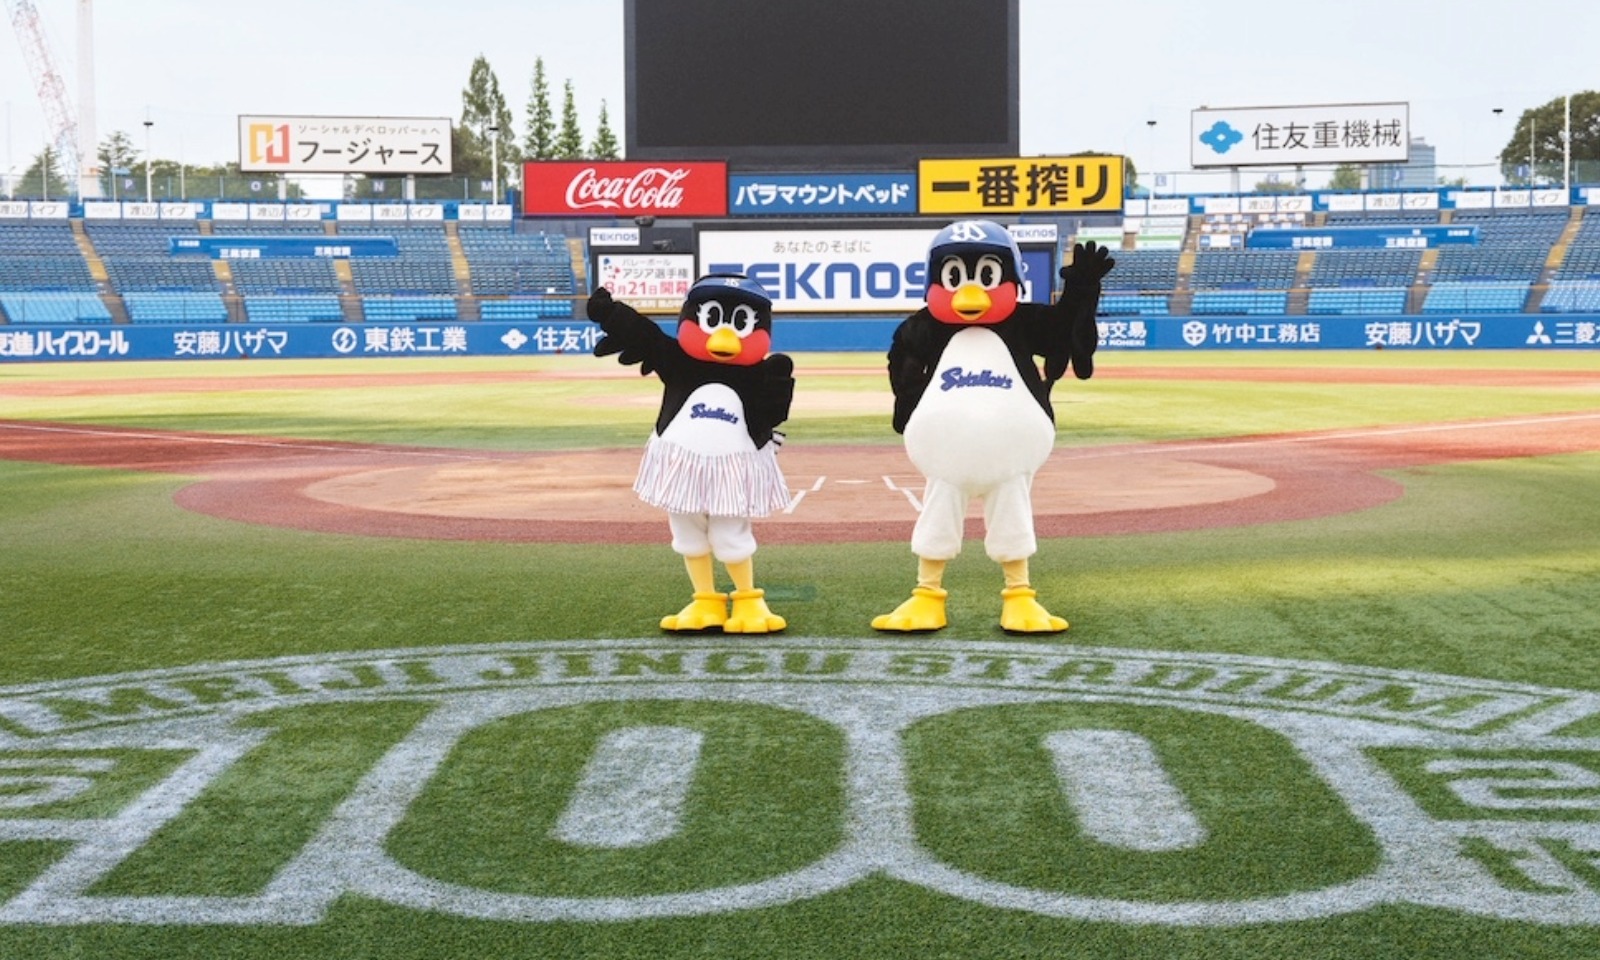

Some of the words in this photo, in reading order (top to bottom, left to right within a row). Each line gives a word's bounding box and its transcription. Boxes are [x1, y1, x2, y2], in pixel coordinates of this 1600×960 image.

[1252, 118, 1402, 151] 住友重機械
[297, 138, 443, 165] フージャース
[565, 168, 692, 209] Coca-Cola
[735, 182, 910, 206] パラマウントベッド
[932, 164, 1109, 207] 一番搾り
[591, 232, 638, 241] TEKNOS
[1011, 229, 1056, 238] TEKNOS
[773, 240, 872, 254] あなたのそばに
[622, 258, 672, 266] バレーボール
[622, 268, 689, 279] アジア選手権
[605, 281, 690, 295] 8月21日開幕
[173, 328, 288, 355] 安藤ハザマ
[364, 326, 467, 352] 東鉄工業
[1212, 322, 1321, 344] 竹中工務店
[1364, 319, 1482, 346] 安藤ハザマ
[1554, 321, 1600, 344] 三菱
[42, 660, 447, 723] MEIJI
[476, 652, 852, 681] JINGU
[886, 653, 1503, 719] STADIUM
[40, 693, 1390, 915] 100
